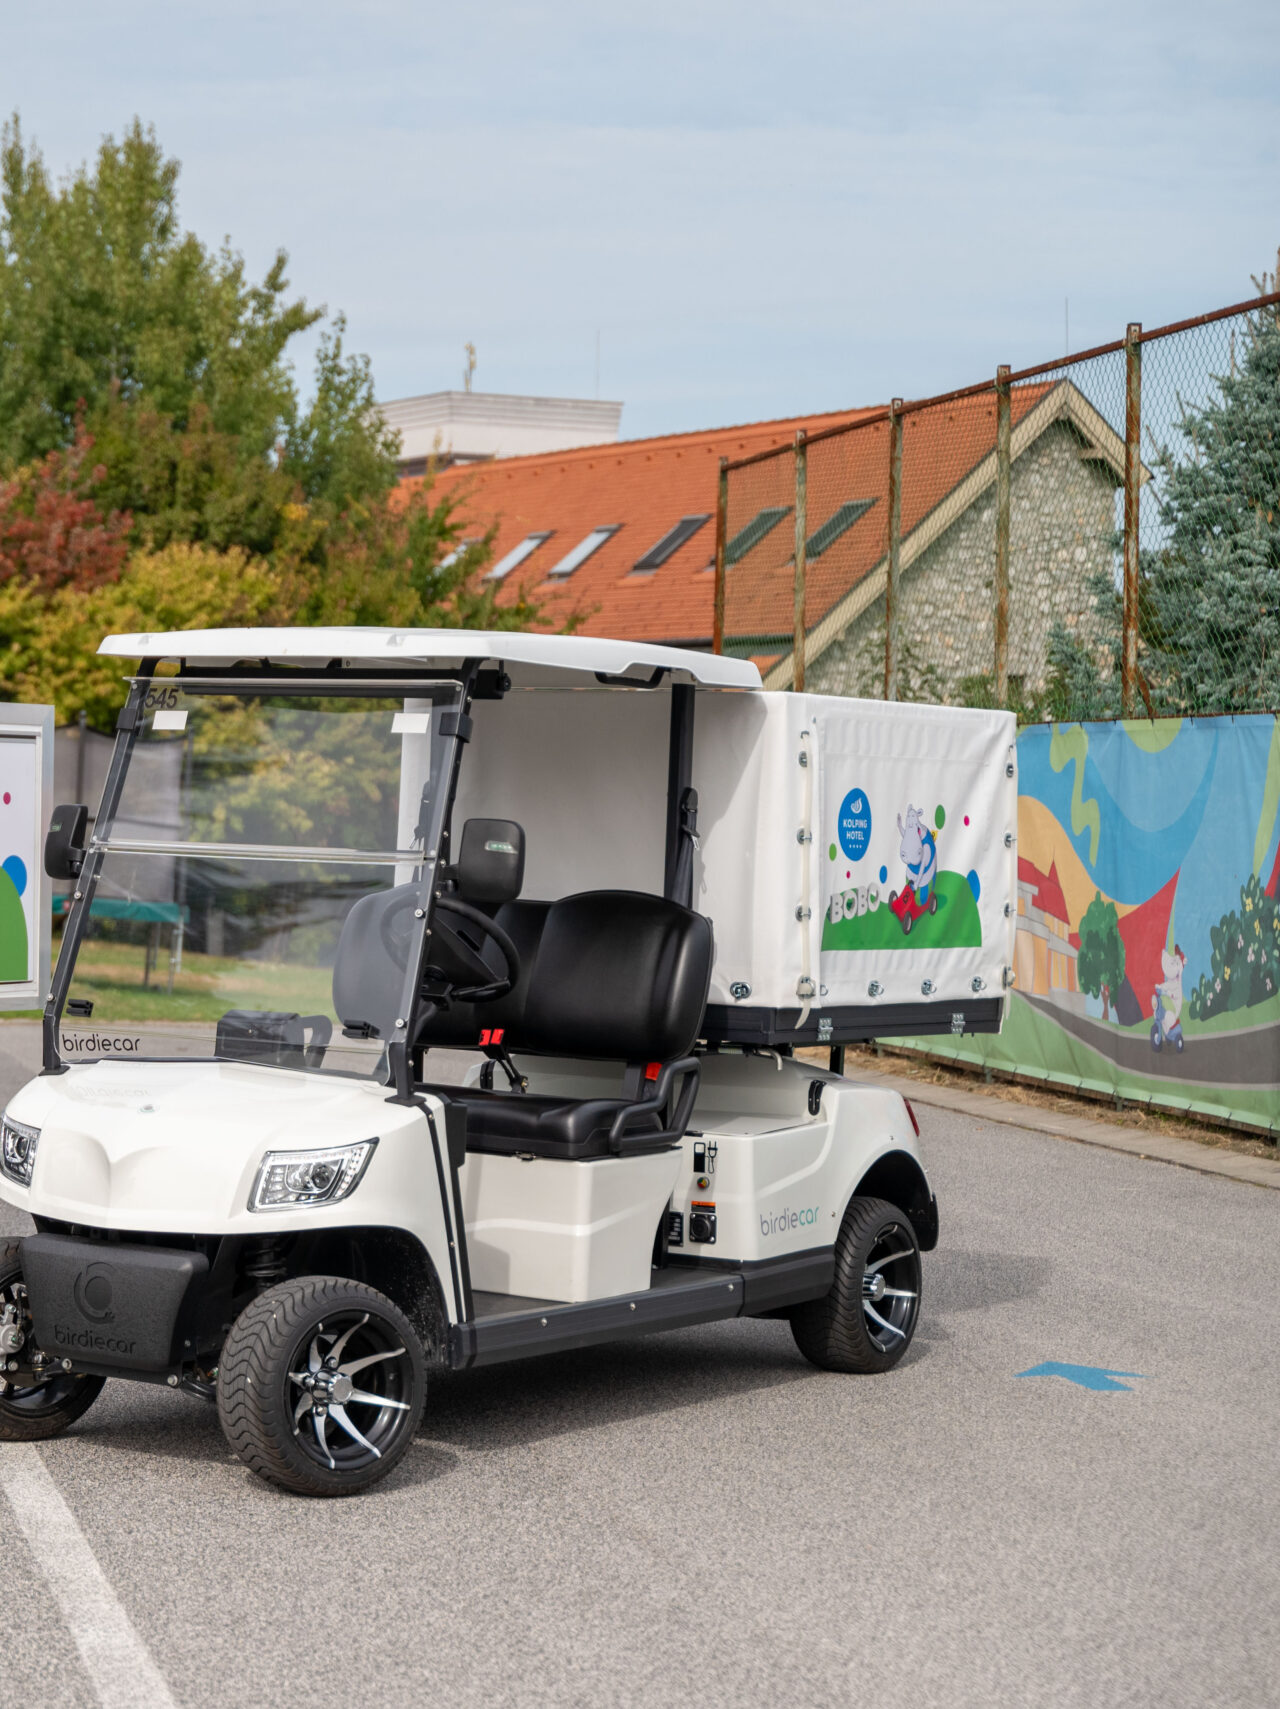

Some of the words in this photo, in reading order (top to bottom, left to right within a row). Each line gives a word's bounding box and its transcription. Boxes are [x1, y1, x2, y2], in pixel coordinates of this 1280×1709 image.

[145, 687, 179, 709] 545
[843, 819, 868, 828] KOLPING
[846, 830, 865, 841] HOTEL
[829, 882, 881, 925] BOBO
[902, 891, 911, 904] 8
[62, 1033, 140, 1052] birdiecar
[759, 1206, 820, 1236] birdiecar
[54, 1323, 137, 1354] birdiecar
